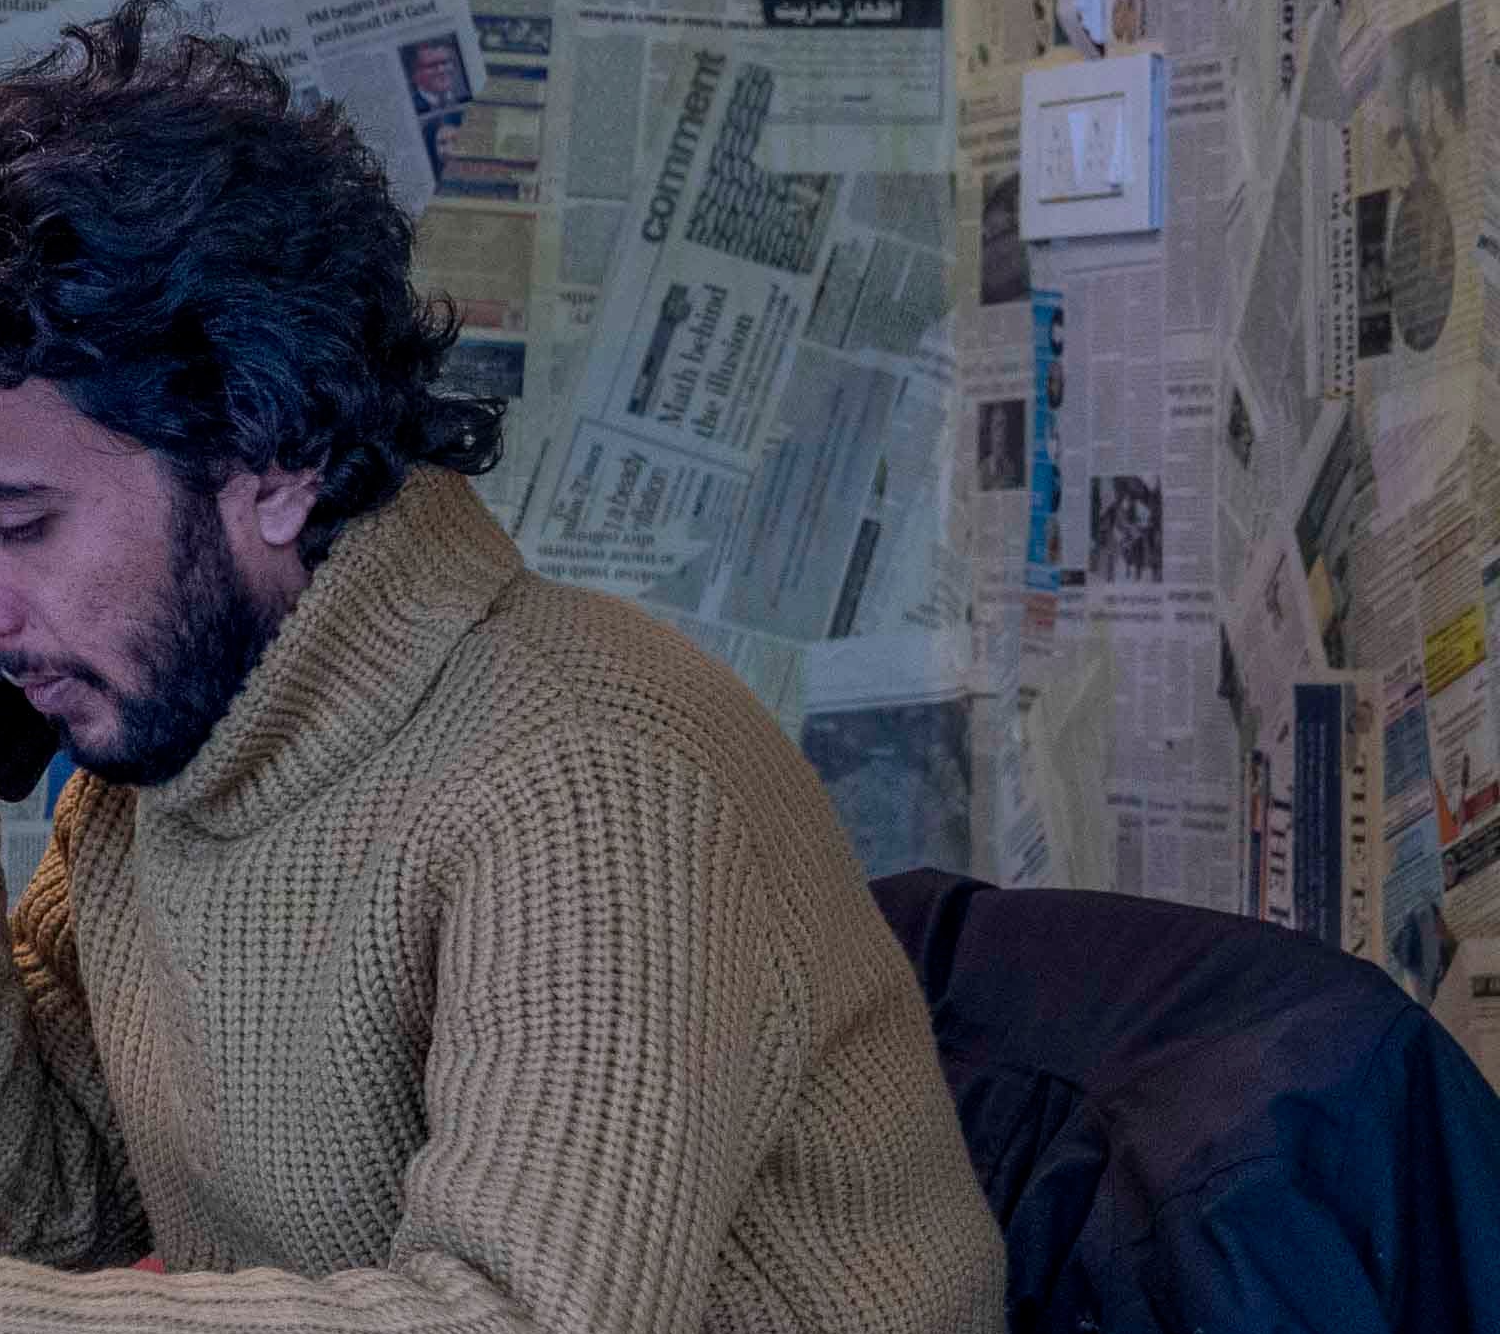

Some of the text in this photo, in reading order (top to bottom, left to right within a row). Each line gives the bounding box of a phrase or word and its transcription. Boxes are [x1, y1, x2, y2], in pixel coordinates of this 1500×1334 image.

[643, 46, 723, 245] comment
[660, 282, 726, 428] Math behind
[705, 309, 751, 400] illusion
